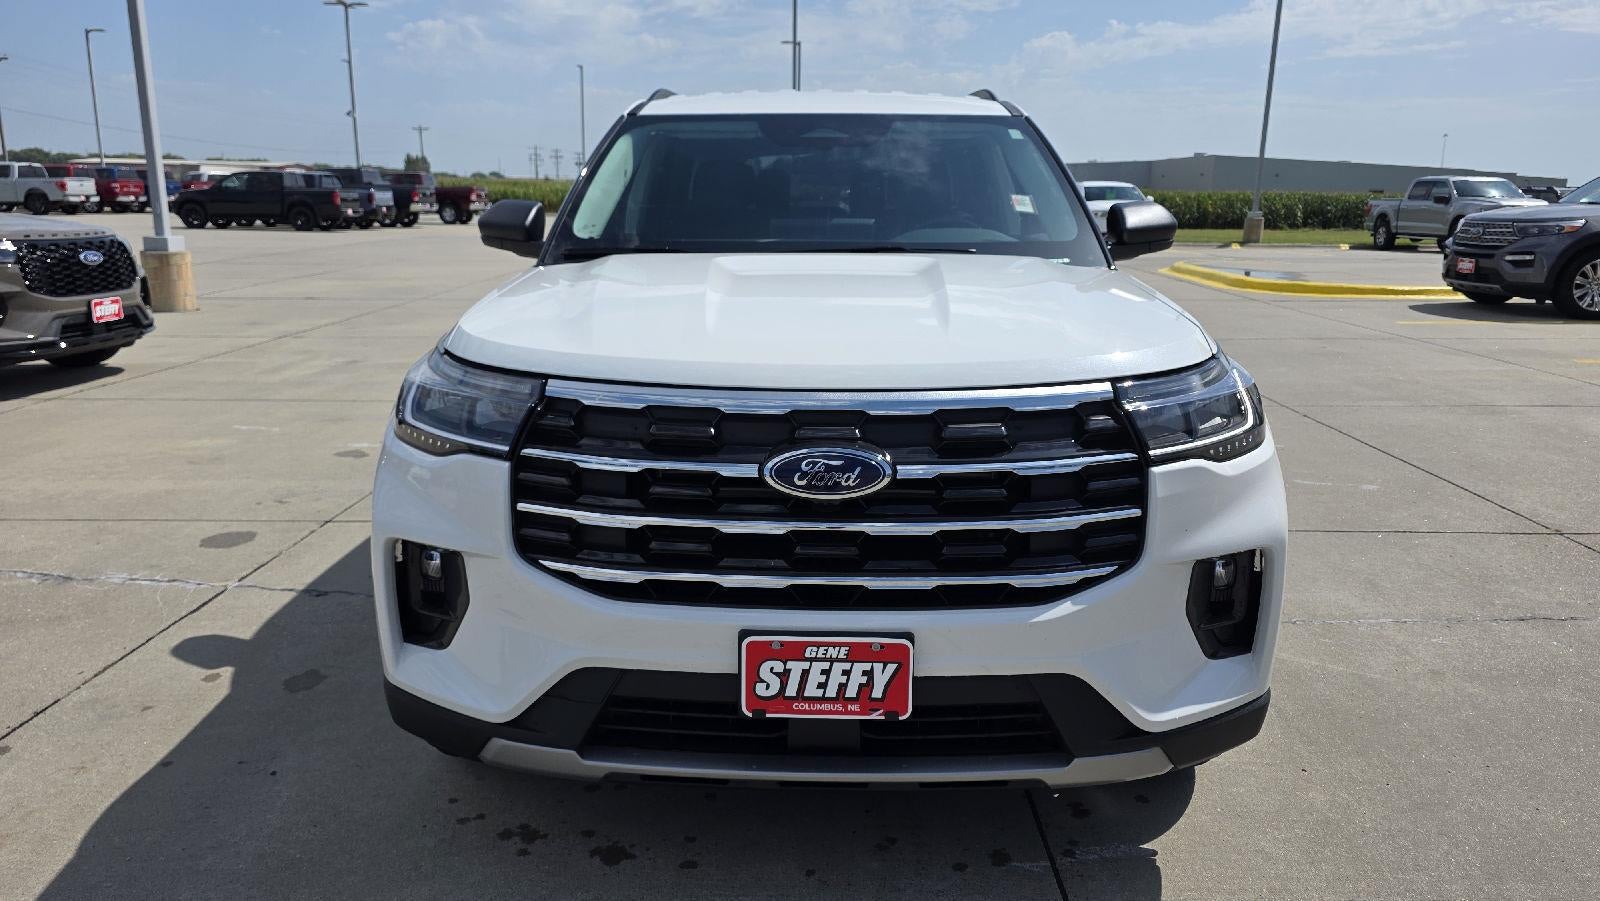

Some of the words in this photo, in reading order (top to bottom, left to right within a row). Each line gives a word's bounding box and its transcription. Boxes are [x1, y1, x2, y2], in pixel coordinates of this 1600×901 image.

[794, 459, 861, 486] Ford
[804, 646, 850, 659] GENE
[755, 660, 900, 699] STEFFY
[792, 703, 845, 712] COLUMBUS,
[848, 704, 861, 712] NE
